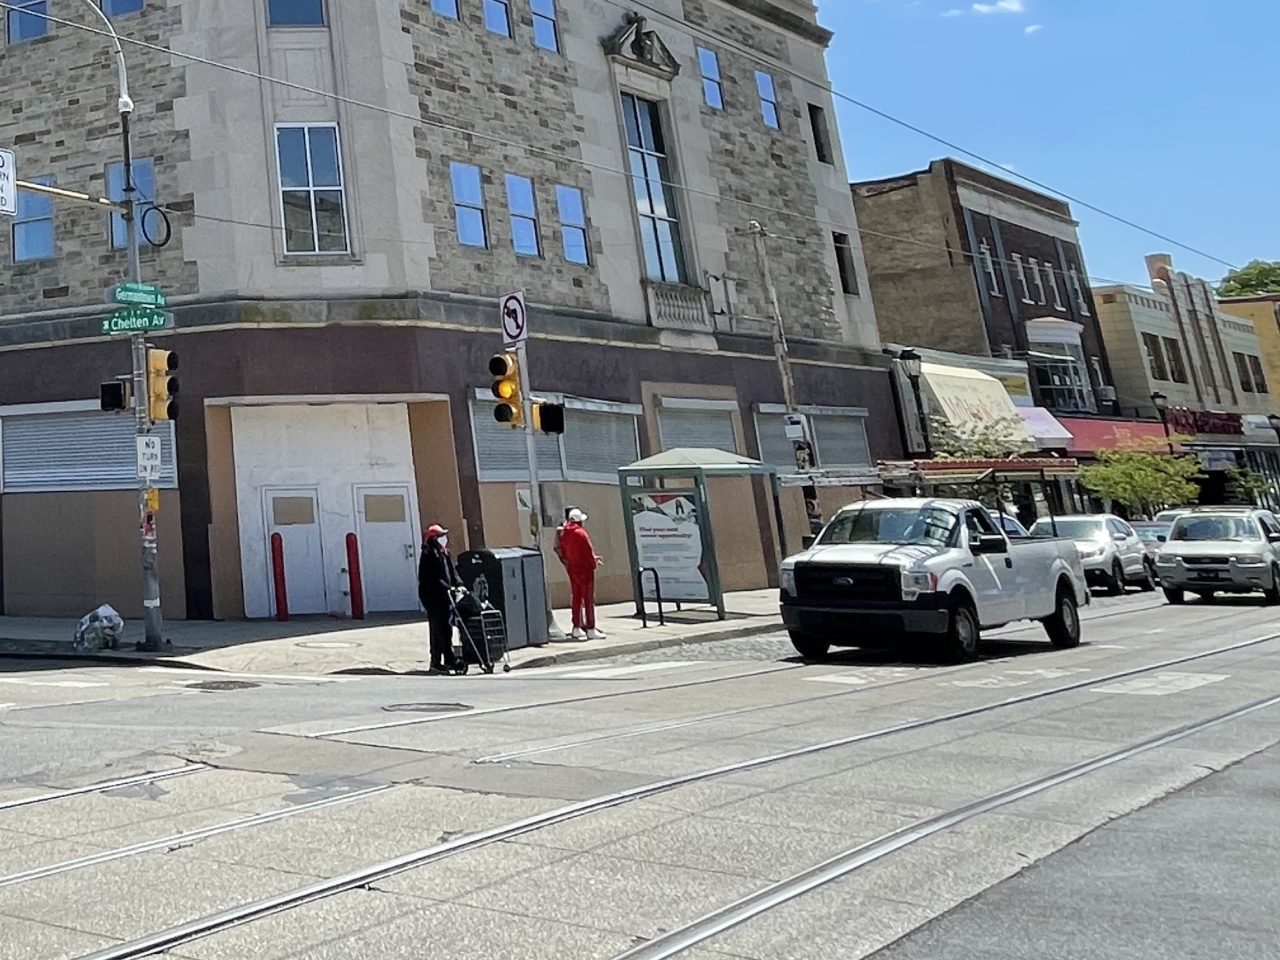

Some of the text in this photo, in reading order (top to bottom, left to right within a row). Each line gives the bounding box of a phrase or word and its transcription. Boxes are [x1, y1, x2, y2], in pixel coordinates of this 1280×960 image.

[111, 317, 149, 330] Chelten
[152, 314, 165, 327] Av
[145, 440, 155, 449] NO
